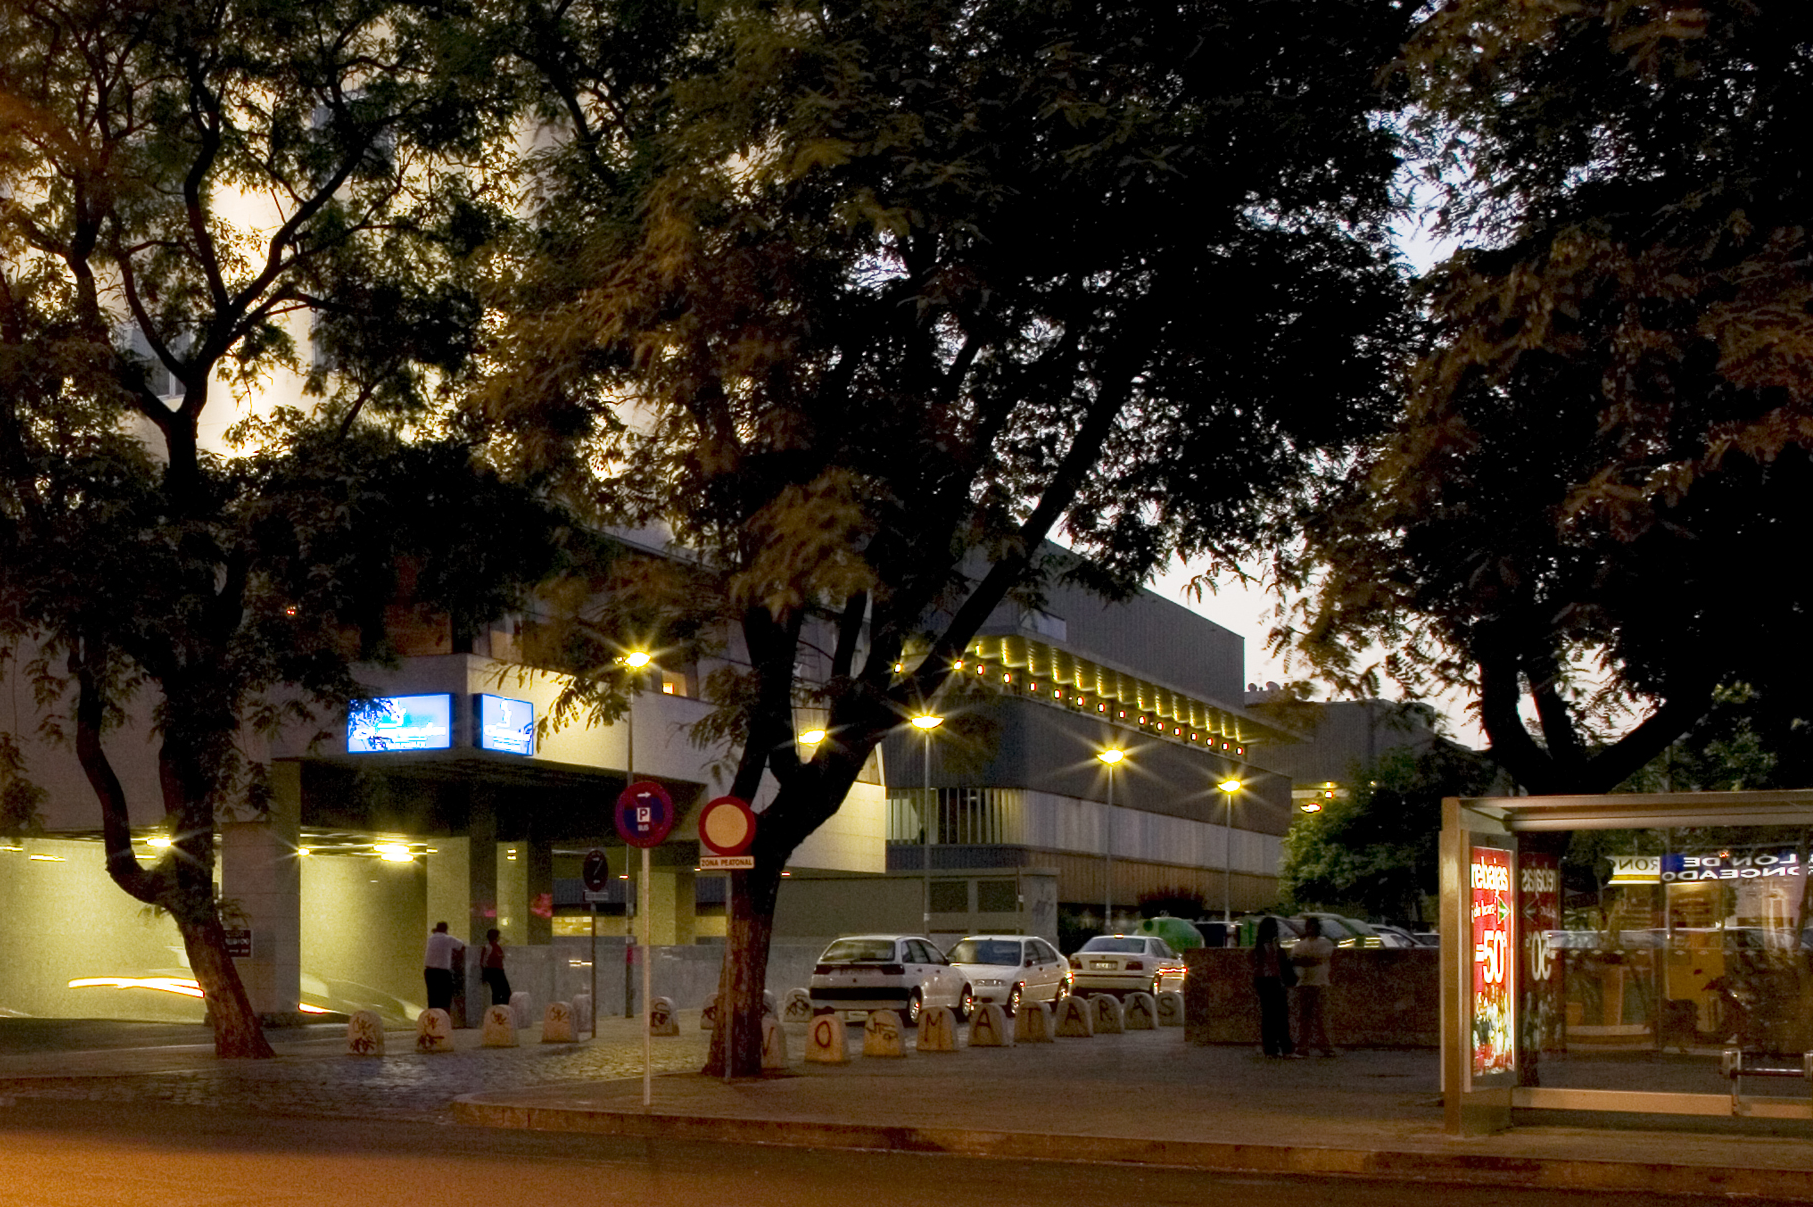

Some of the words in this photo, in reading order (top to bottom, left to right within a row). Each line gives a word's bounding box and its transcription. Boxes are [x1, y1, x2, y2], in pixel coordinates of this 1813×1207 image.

[701, 859, 719, 867] ZONA
[721, 858, 753, 867] PEATONAL
[1471, 856, 1509, 897] rebajas
